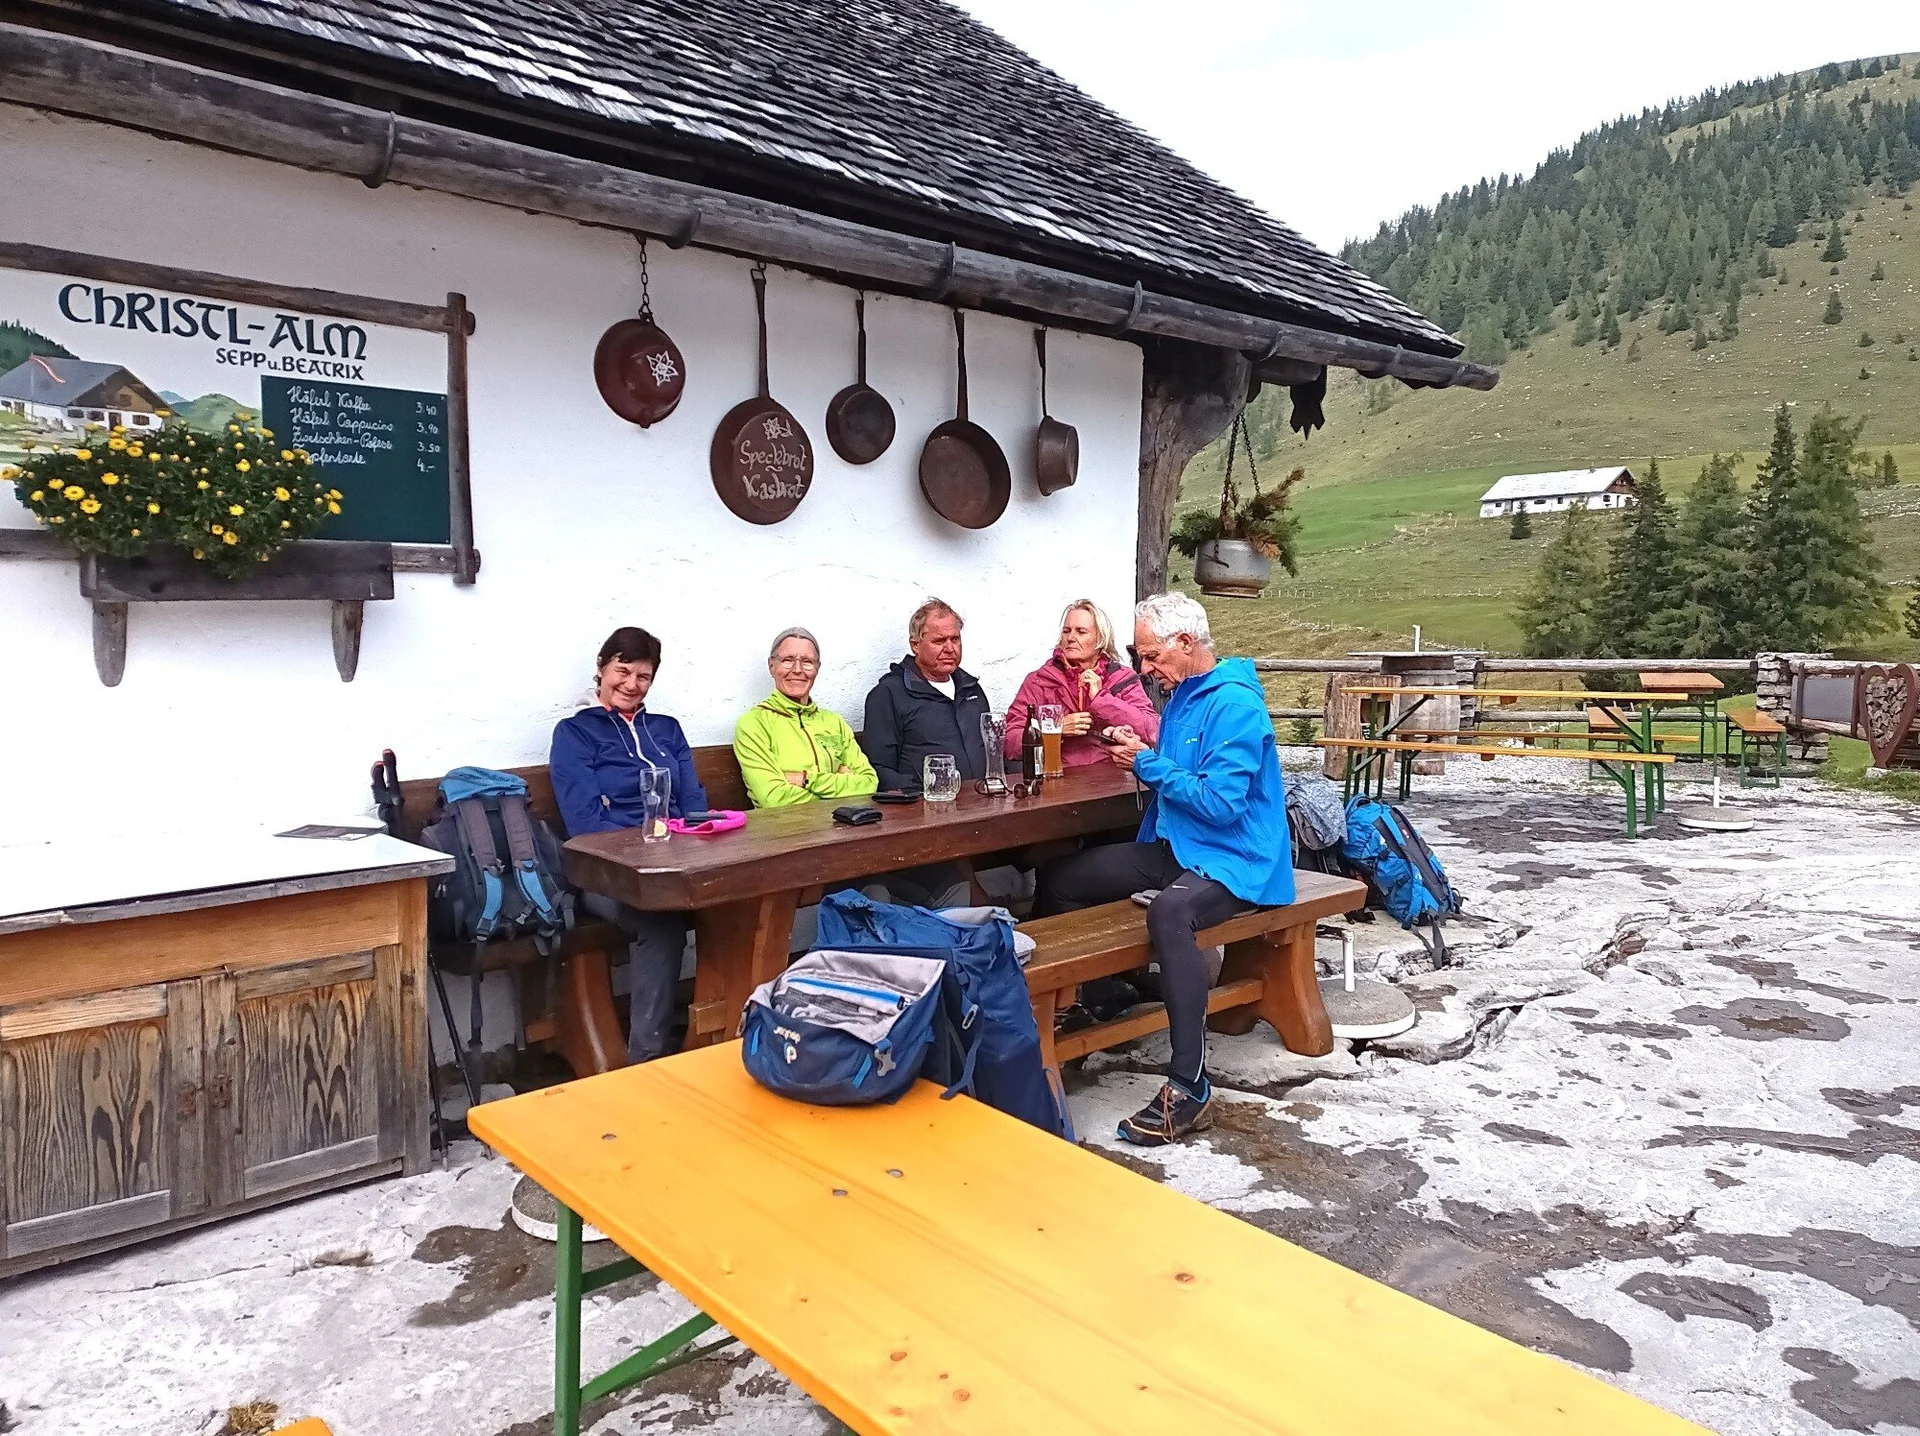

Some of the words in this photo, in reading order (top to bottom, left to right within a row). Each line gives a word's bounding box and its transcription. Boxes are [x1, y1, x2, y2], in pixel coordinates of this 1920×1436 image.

[215, 347, 267, 369] SEPP
[282, 355, 365, 381] BEATRIX
[335, 391, 372, 414] Kaffee
[336, 412, 394, 434] Cappucino
[416, 421, 439, 435] 3.90
[417, 441, 441, 453] 3.50
[739, 439, 807, 471] Speckbrot
[741, 472, 806, 500] Kasbrot
